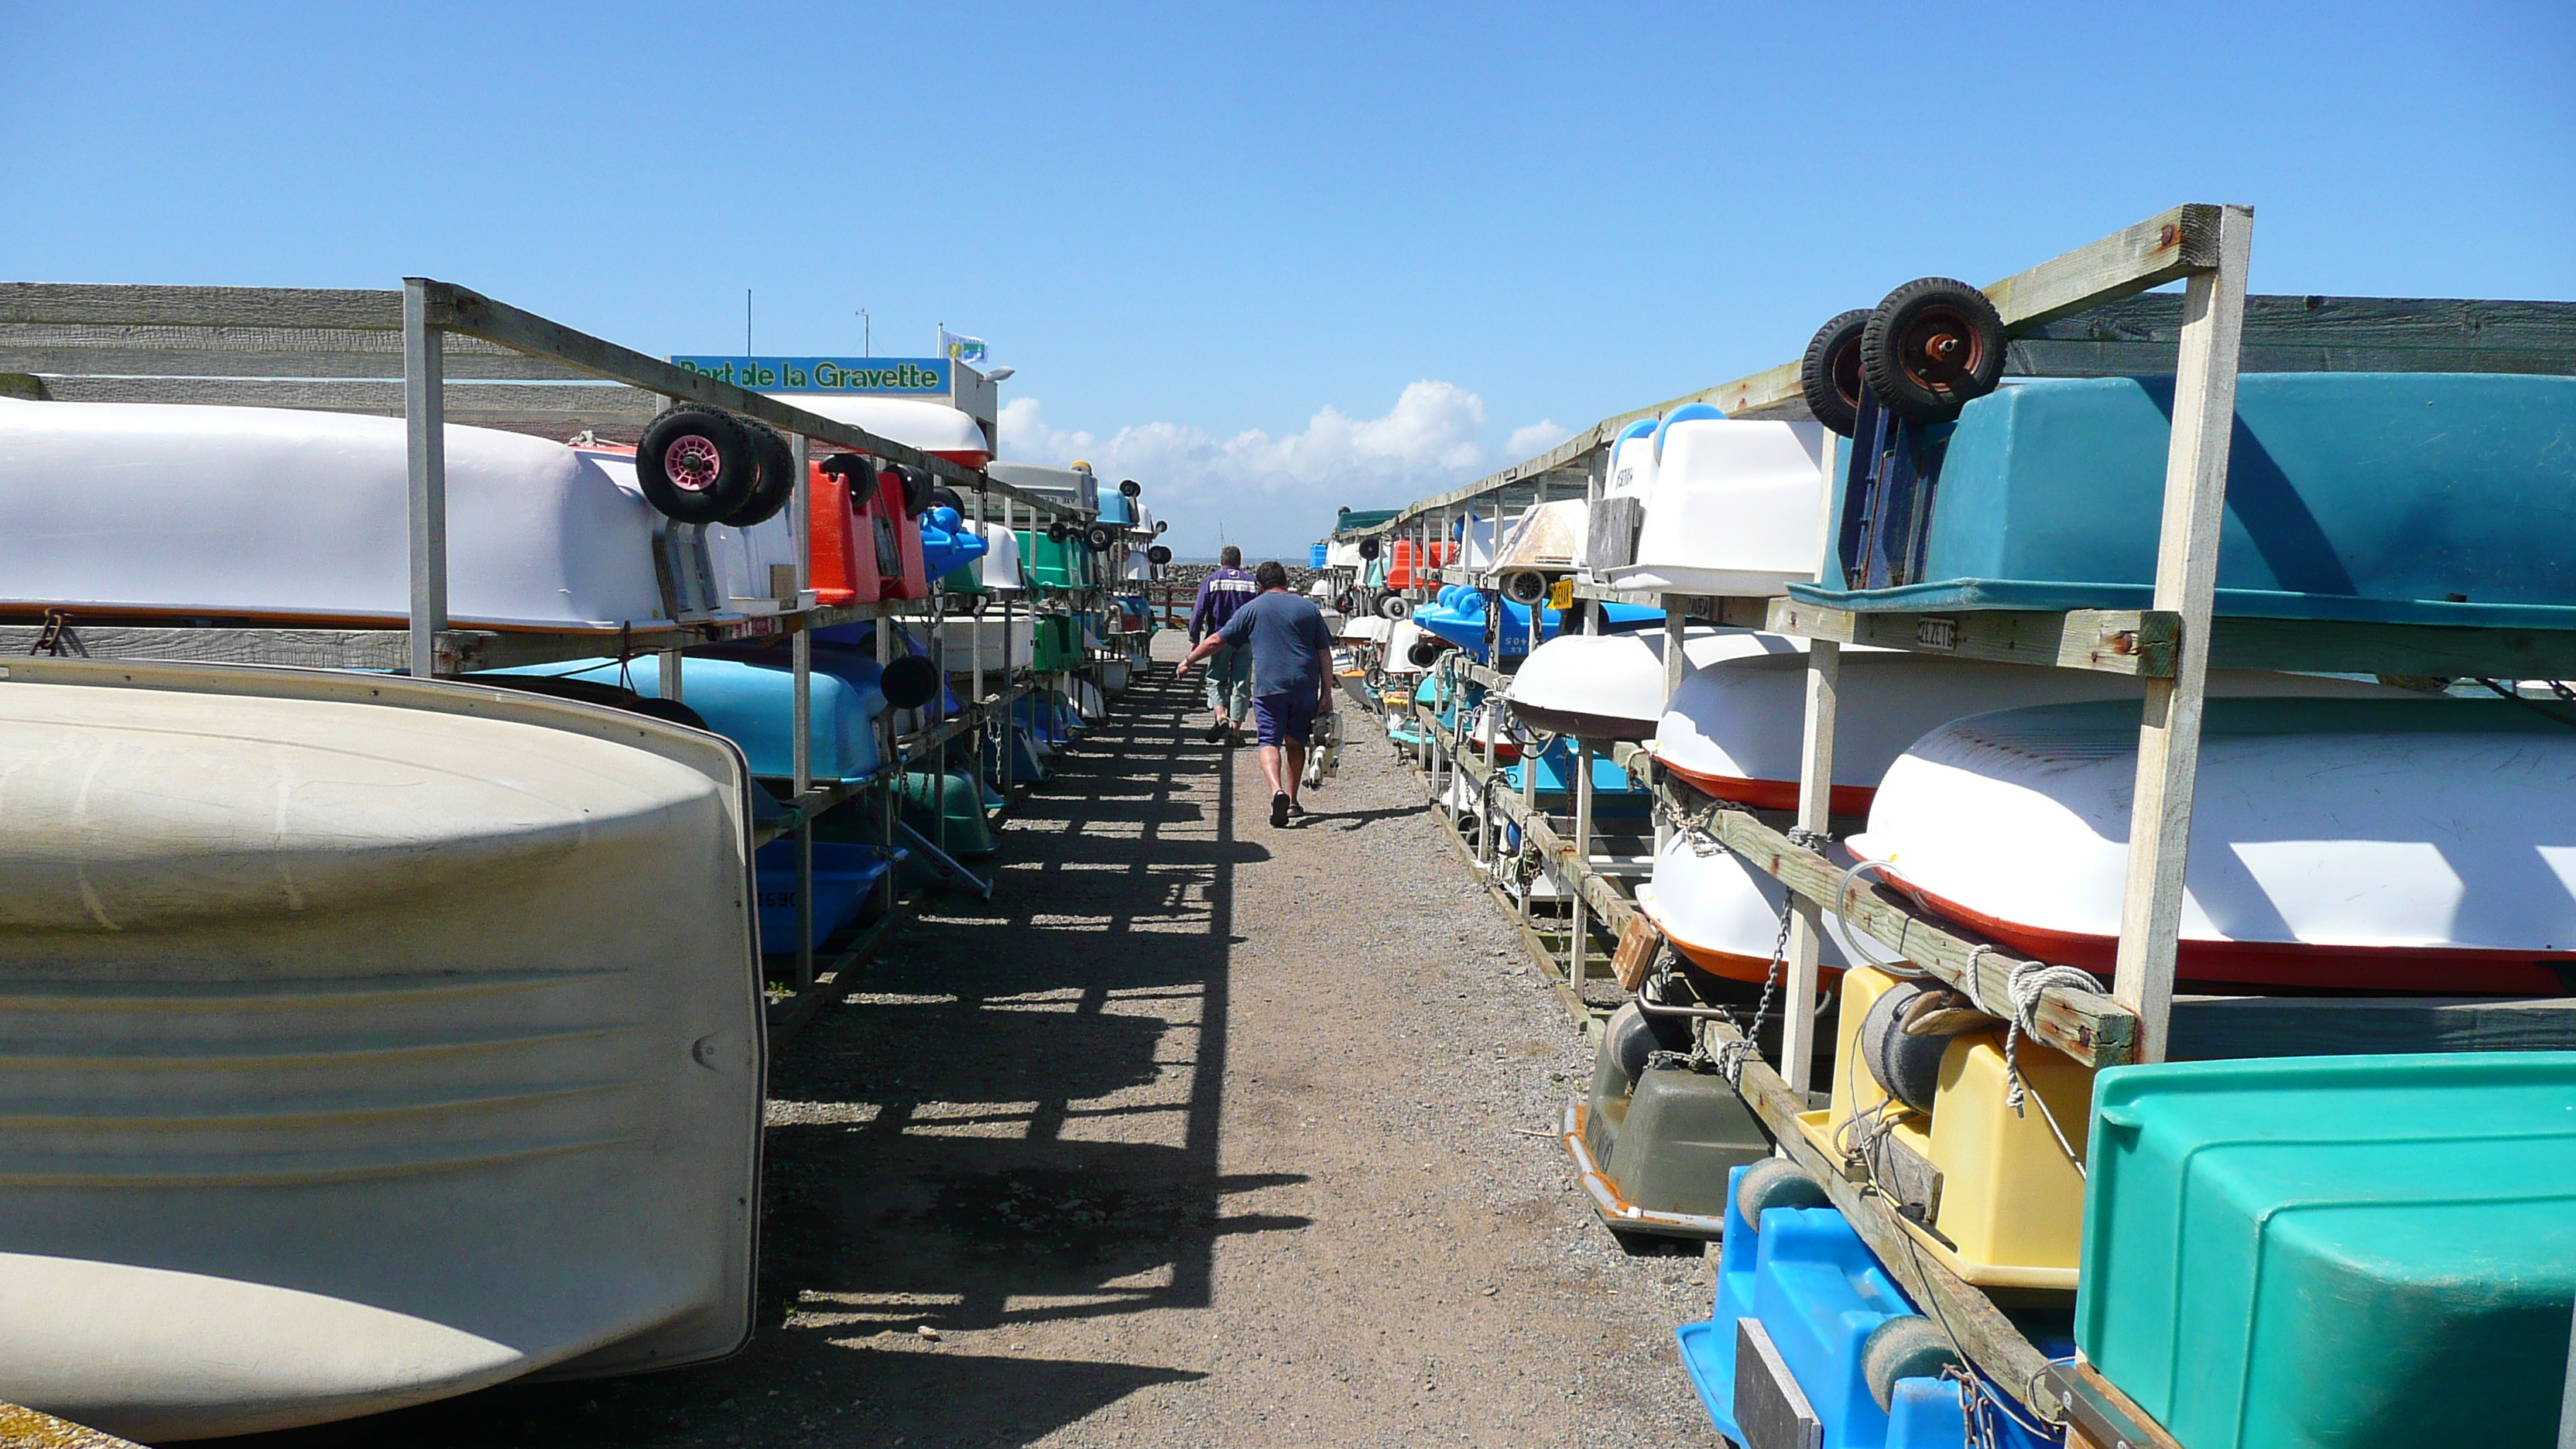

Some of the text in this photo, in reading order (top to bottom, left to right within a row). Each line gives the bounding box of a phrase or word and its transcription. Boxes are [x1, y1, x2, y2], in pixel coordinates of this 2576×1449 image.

[741, 361, 775, 387] de
[783, 362, 807, 387] la
[814, 361, 938, 389] Gravette
